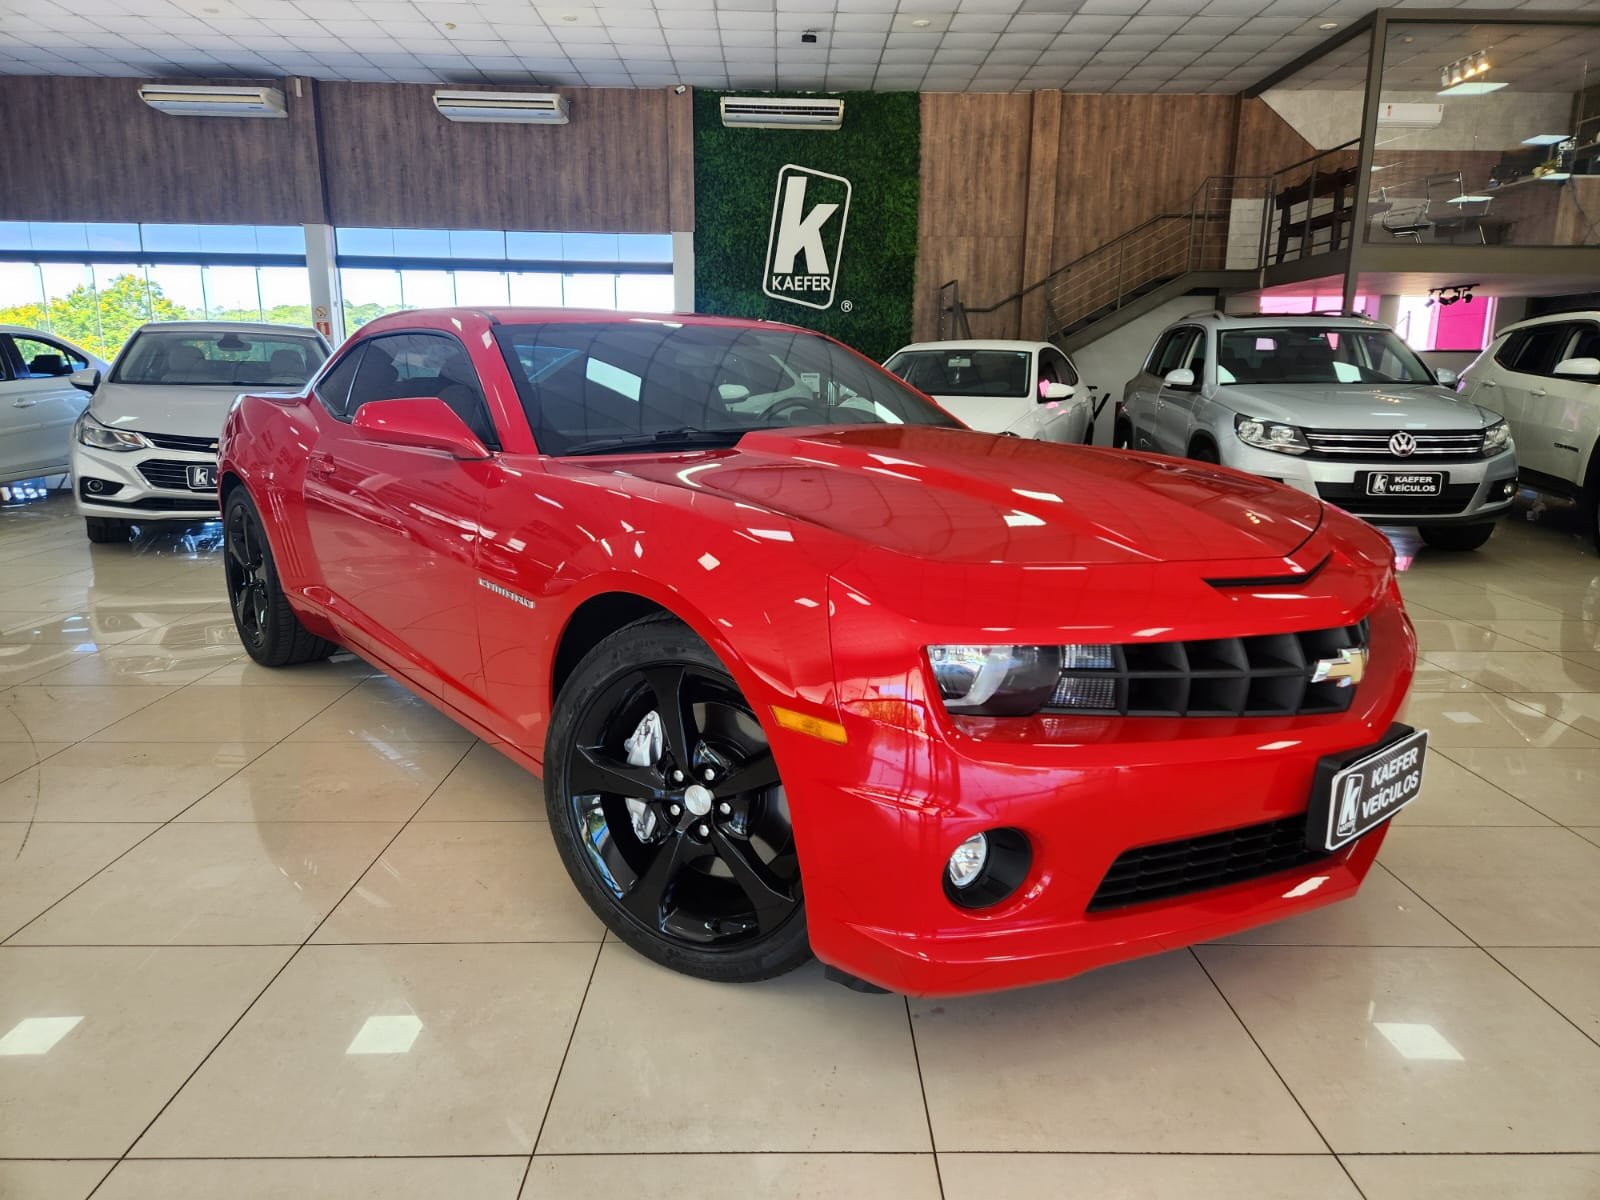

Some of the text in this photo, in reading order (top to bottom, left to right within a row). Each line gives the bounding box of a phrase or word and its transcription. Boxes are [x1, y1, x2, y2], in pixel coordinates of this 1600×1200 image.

[771, 275, 832, 292] KAEFER
[1389, 483, 1436, 492] VEÍCULOS
[1394, 475, 1433, 483] KAEFER
[1370, 747, 1419, 789] KAEFER
[1362, 769, 1420, 819] VEÍCULOS
